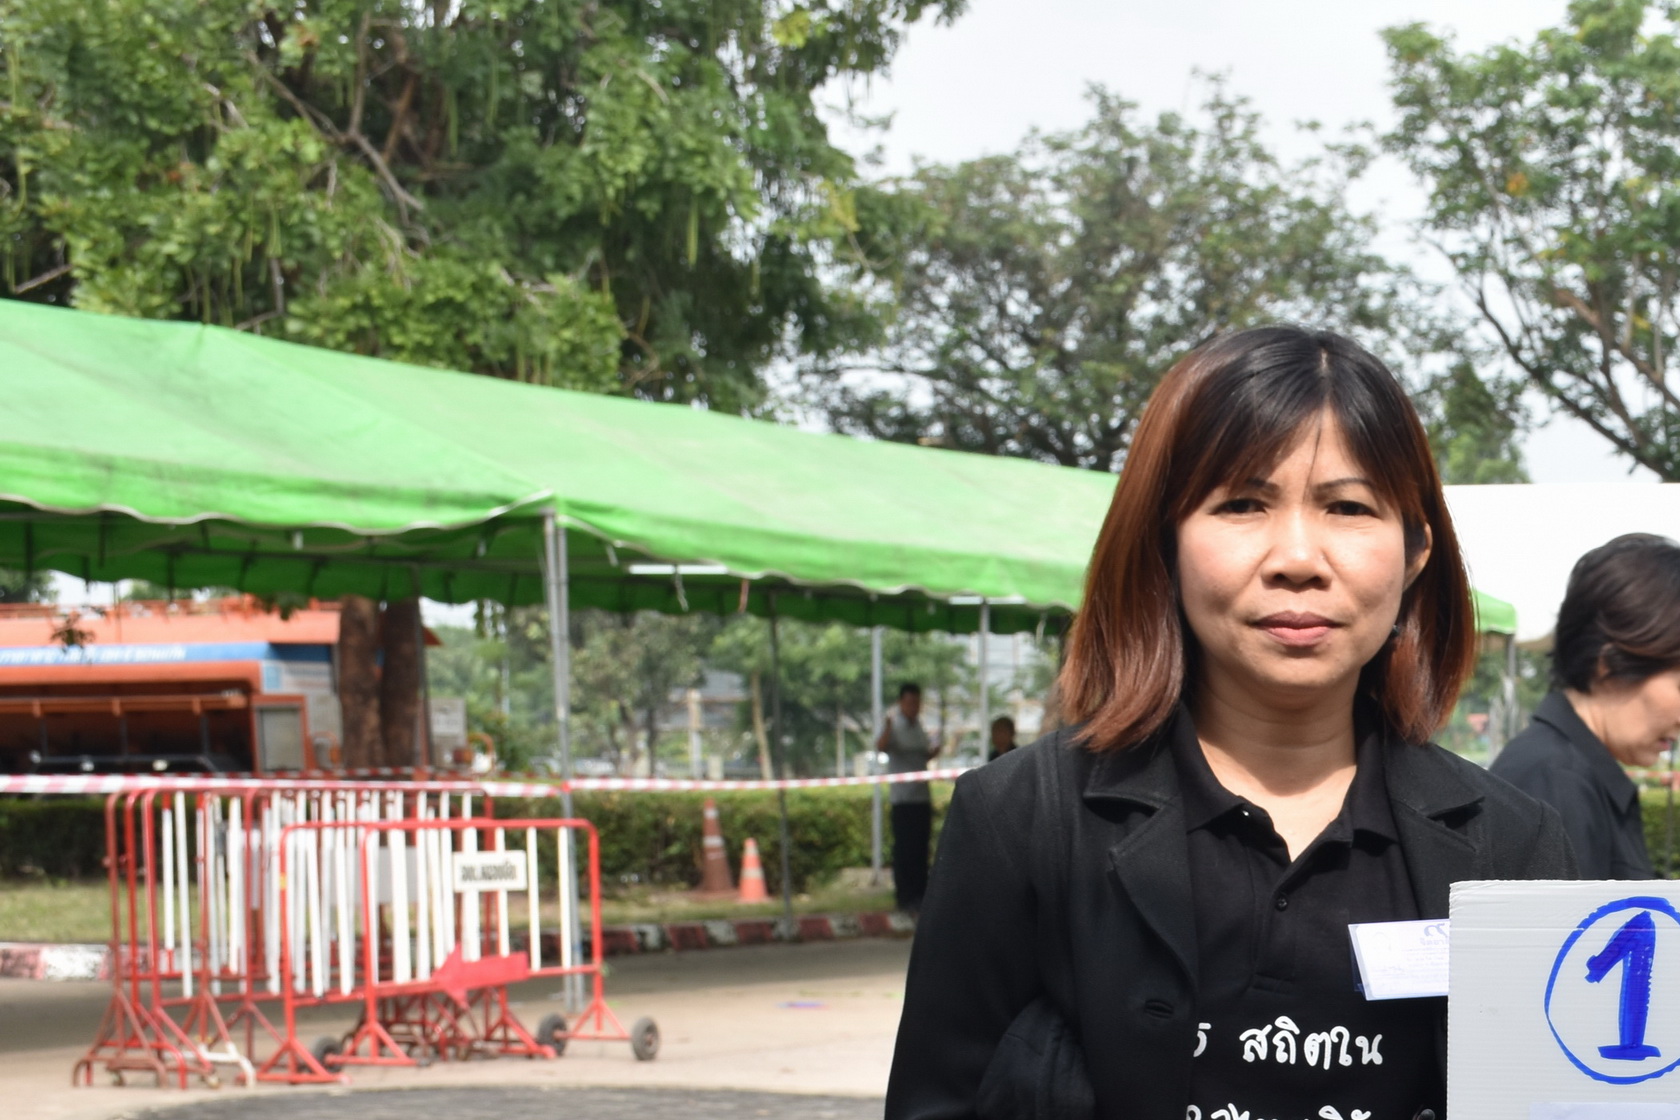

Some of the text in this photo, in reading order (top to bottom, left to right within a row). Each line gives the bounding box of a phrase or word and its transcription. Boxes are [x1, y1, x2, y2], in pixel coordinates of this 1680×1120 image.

[1585, 910, 1662, 1061] 1
[1239, 1015, 1383, 1071] สถิตใน
